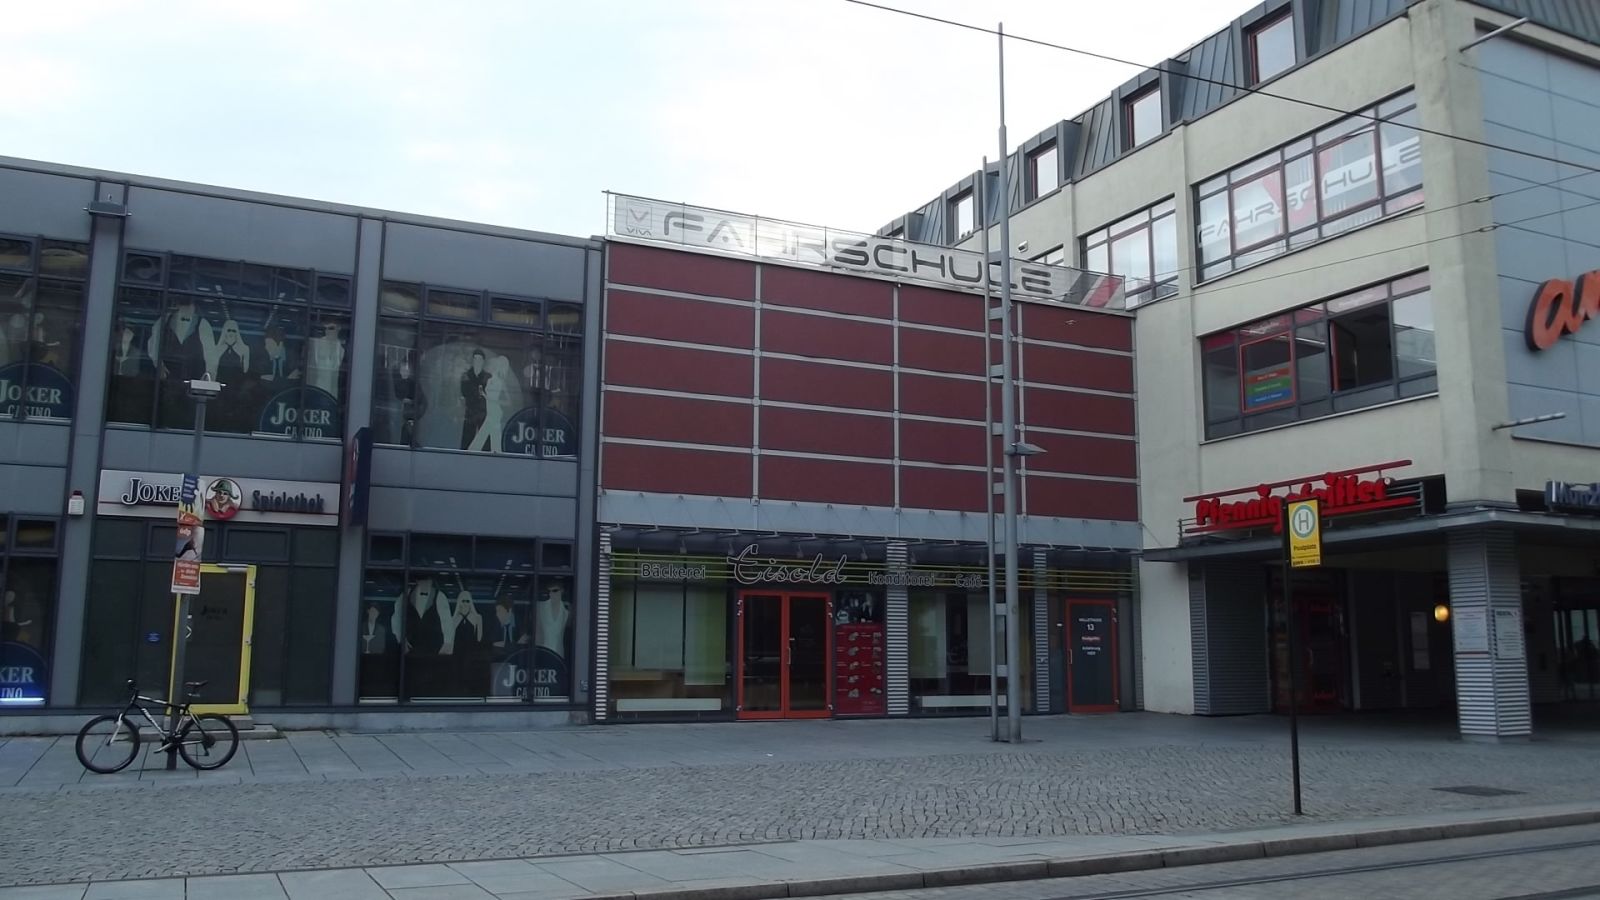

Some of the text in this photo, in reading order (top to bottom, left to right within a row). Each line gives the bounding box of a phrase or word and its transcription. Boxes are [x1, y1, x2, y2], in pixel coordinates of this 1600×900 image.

[285, 425, 322, 439] CAINO
[525, 444, 558, 456] CAINO
[122, 477, 182, 505] JOKE
[252, 490, 325, 514] Spielothek
[1196, 471, 1386, 535] Pfennigfeiffer
[641, 562, 706, 580] Bäckerei
[726, 543, 848, 585] Eisold
[868, 571, 935, 586] Konditorei
[516, 686, 550, 698] CAINO
